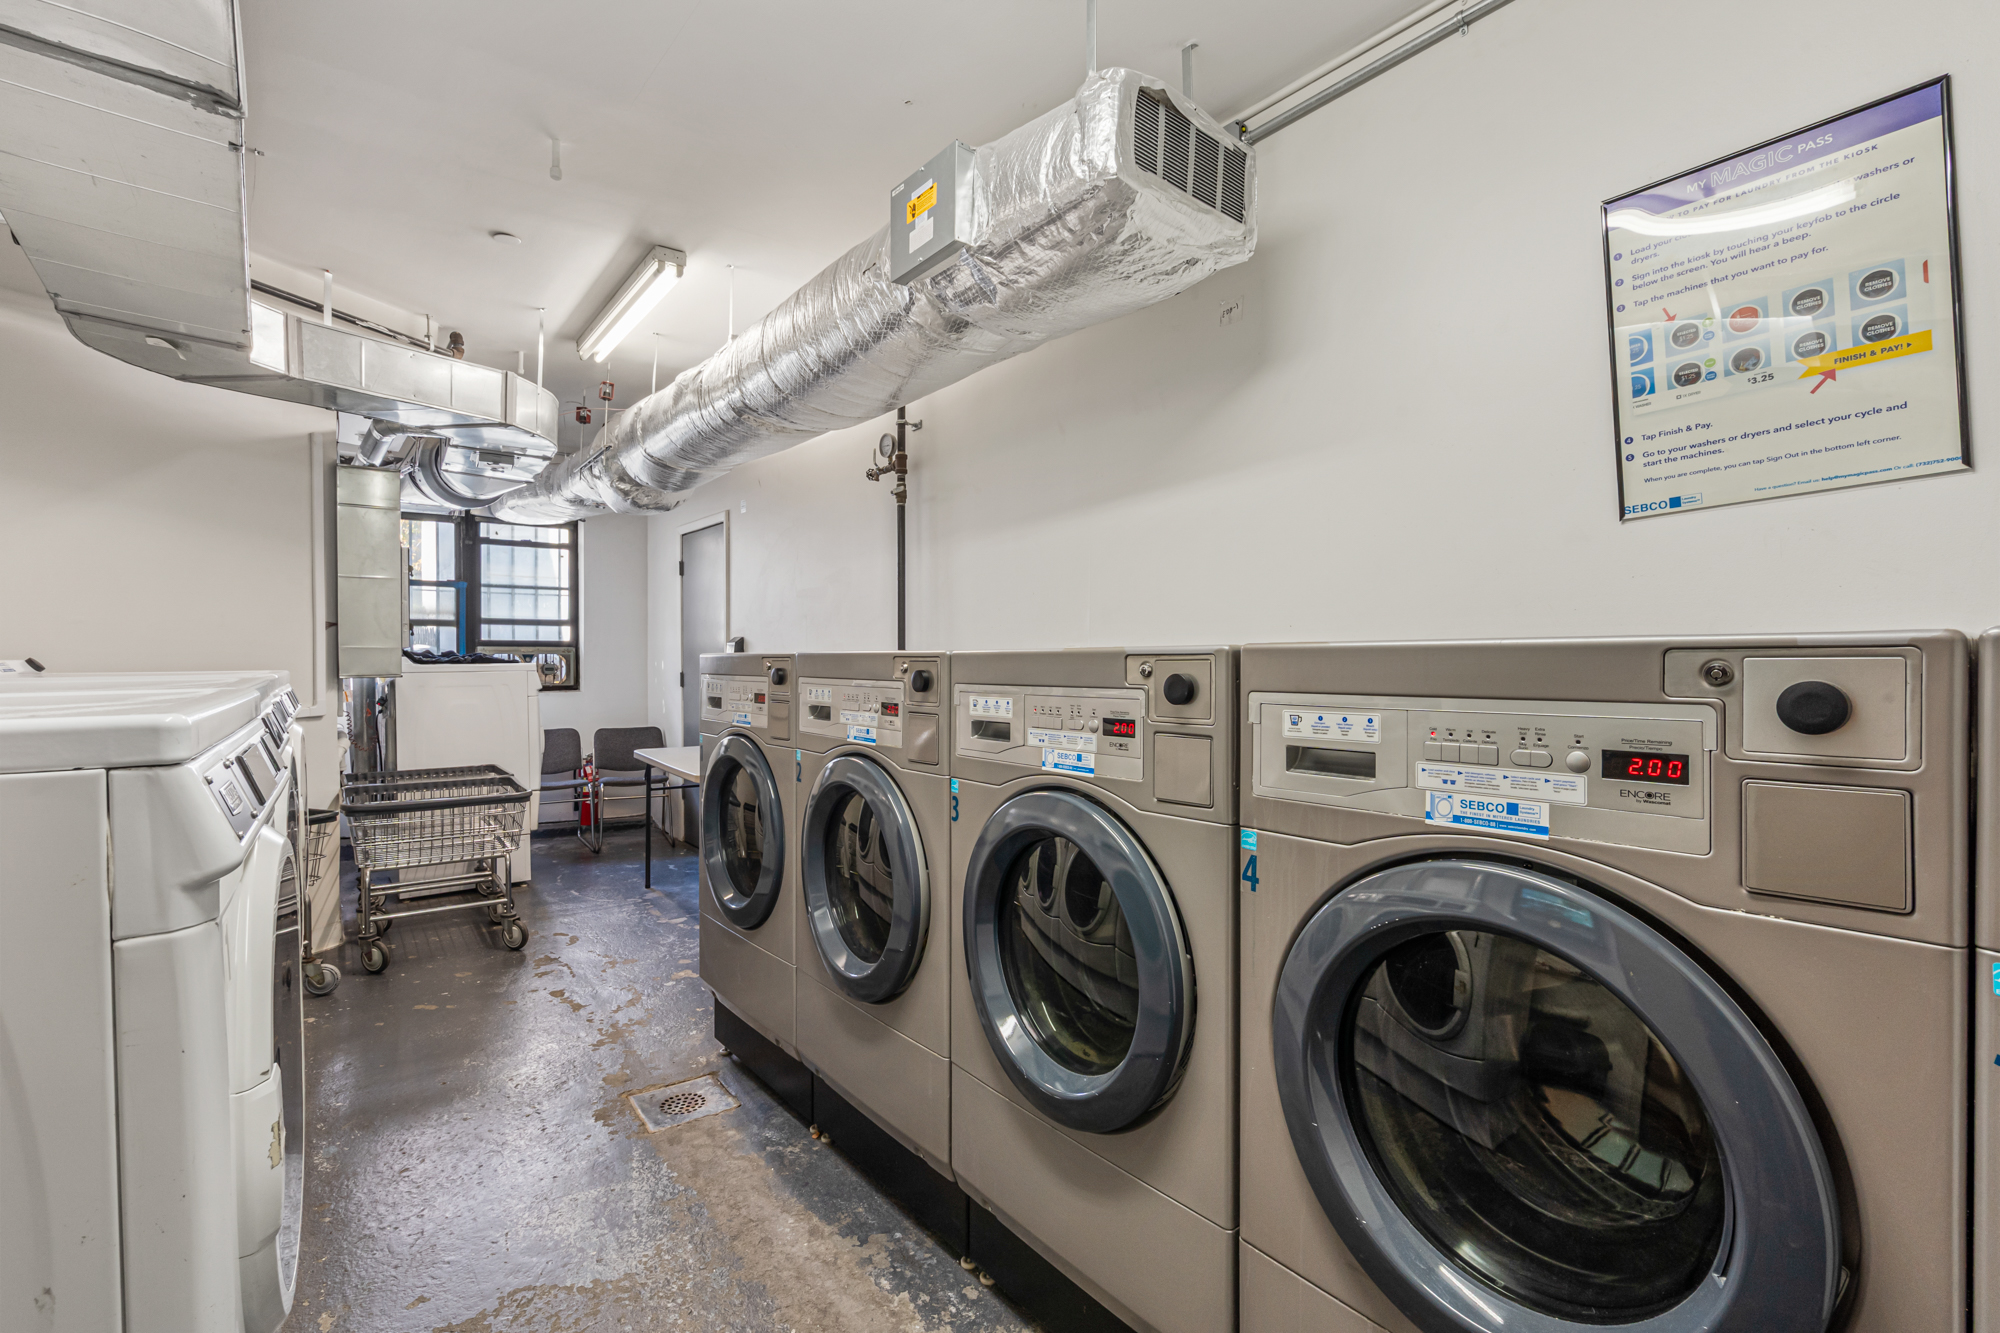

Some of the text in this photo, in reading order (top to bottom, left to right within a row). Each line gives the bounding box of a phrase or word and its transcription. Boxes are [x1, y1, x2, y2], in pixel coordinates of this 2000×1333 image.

[1686, 133, 1833, 194] MY MAGIC PASS
[1853, 156, 1916, 182] washers or
[1677, 209, 1690, 217] TO
[1692, 201, 1710, 212] PAY
[1713, 195, 1732, 205] FOR
[1735, 178, 1782, 198] LAUNDRY
[1785, 166, 1815, 181] FROM
[1819, 157, 1839, 169] THE
[1843, 143, 1878, 161] KIOSK
[1631, 270, 1651, 283] Sign
[1651, 265, 1669, 275] into
[1670, 259, 1686, 270] the
[1687, 252, 1711, 264] kiosk
[1713, 248, 1725, 259] by
[1726, 233, 1769, 251] touching
[1771, 226, 1793, 239] your
[1796, 214, 1833, 230] keyfob
[1835, 209, 1847, 218] to
[1849, 203, 1868, 214] the
[1870, 192, 1901, 207] circle
[1630, 243, 1652, 256] Load
[1653, 237, 1673, 250] your
[1630, 252, 1660, 265] dryers.
[1632, 278, 1658, 291] below
[1660, 271, 1675, 282] the
[1676, 264, 1709, 278] screen.
[1710, 256, 1728, 267] You
[1729, 249, 1747, 261] will
[1749, 243, 1772, 255] hear
[1782, 232, 1812, 246] beep.
[1633, 295, 1649, 308] Tap
[1650, 290, 1665, 302] the
[1666, 280, 1709, 298] machines
[1710, 274, 1730, 285] that
[1730, 269, 1749, 281] you
[1750, 261, 1776, 273] want
[1777, 256, 1788, 265] to
[1790, 250, 1809, 263] pay
[1811, 245, 1829, 255] for.
[1864, 276, 1891, 287] REMOVE
[1863, 281, 1892, 292] CLOTHES
[1796, 295, 1821, 306] REMOVE
[1796, 300, 1822, 310] CLOTHES
[1866, 326, 1895, 337] CLOTHES
[1867, 321, 1894, 332] REMOVE
[1798, 338, 1823, 348] REMOVE
[1798, 342, 1825, 353] CLOTHES
[1833, 343, 1904, 365] FINISH & PAY!
[1747, 372, 1775, 384] $3.25
[1641, 432, 1657, 441] Tap
[1658, 426, 1684, 438] Finish
[1695, 421, 1713, 430] Pay.
[1642, 450, 1656, 458] Go
[1657, 448, 1666, 456] to
[1667, 444, 1688, 455] your
[1689, 436, 1726, 449] washers
[1740, 428, 1771, 440] dryers
[1773, 423, 1793, 433] and
[1794, 416, 1826, 429] select
[1827, 413, 1853, 425] your
[1854, 406, 1883, 419] cycle
[1885, 401, 1908, 412] and
[1642, 448, 1725, 467] start the machines.
[1643, 475, 1663, 483] When
[1663, 473, 1676, 481] you
[1689, 465, 1723, 476] complete,
[1723, 463, 1737, 471] you
[1752, 457, 1765, 466] tap
[1766, 454, 1783, 463] Sign
[1784, 451, 1799, 459] Out
[1809, 447, 1823, 455] the
[1824, 442, 1855, 452] bottom
[1856, 439, 1871, 447] left
[1872, 436, 1902, 445] corner.
[1821, 467, 1893, 482] help@mymagicpass.com
[1624, 500, 1668, 515] SEBCO
[1056, 752, 1077, 761] SEBCO
[796, 762, 802, 783] 2
[1628, 757, 1683, 779] 2.00
[1619, 789, 1672, 801] ENCORE
[951, 795, 960, 822] 3
[1459, 799, 1505, 814] SEBCO
[1492, 813, 1513, 821] METERED
[1514, 816, 1541, 825] LAUNDRIES
[1241, 854, 1260, 893] 4
